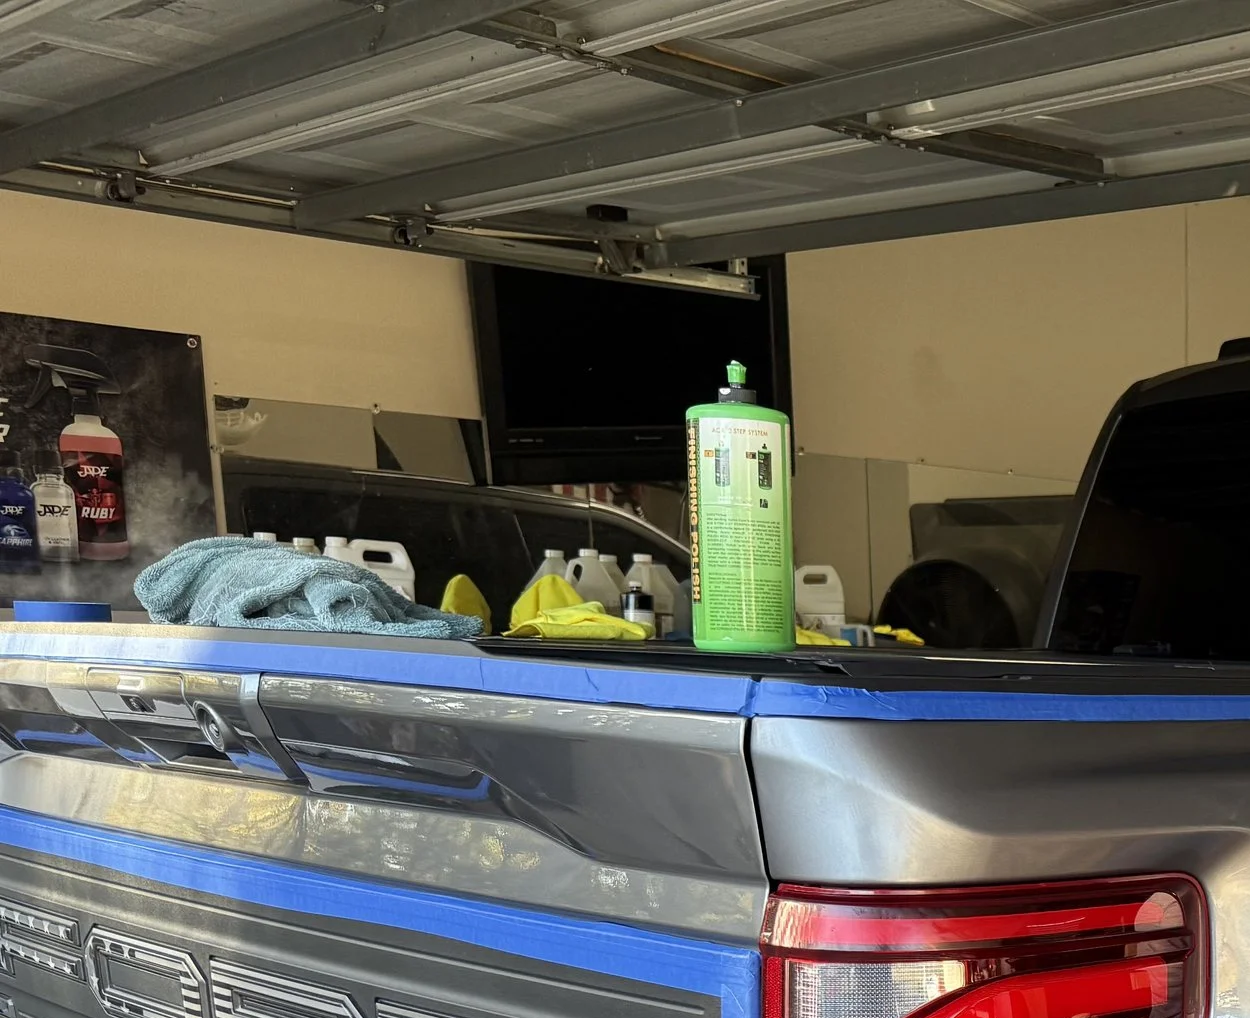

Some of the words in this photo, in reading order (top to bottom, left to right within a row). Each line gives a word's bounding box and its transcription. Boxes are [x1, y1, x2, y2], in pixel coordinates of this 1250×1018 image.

[733, 427, 747, 435] STEP
[748, 428, 769, 437] SYSTEM
[77, 465, 109, 478] JADE
[688, 427, 698, 527] FINISHING
[37, 504, 72, 517] JADE
[81, 506, 116, 519] RUBY
[690, 531, 701, 600] POLISH
